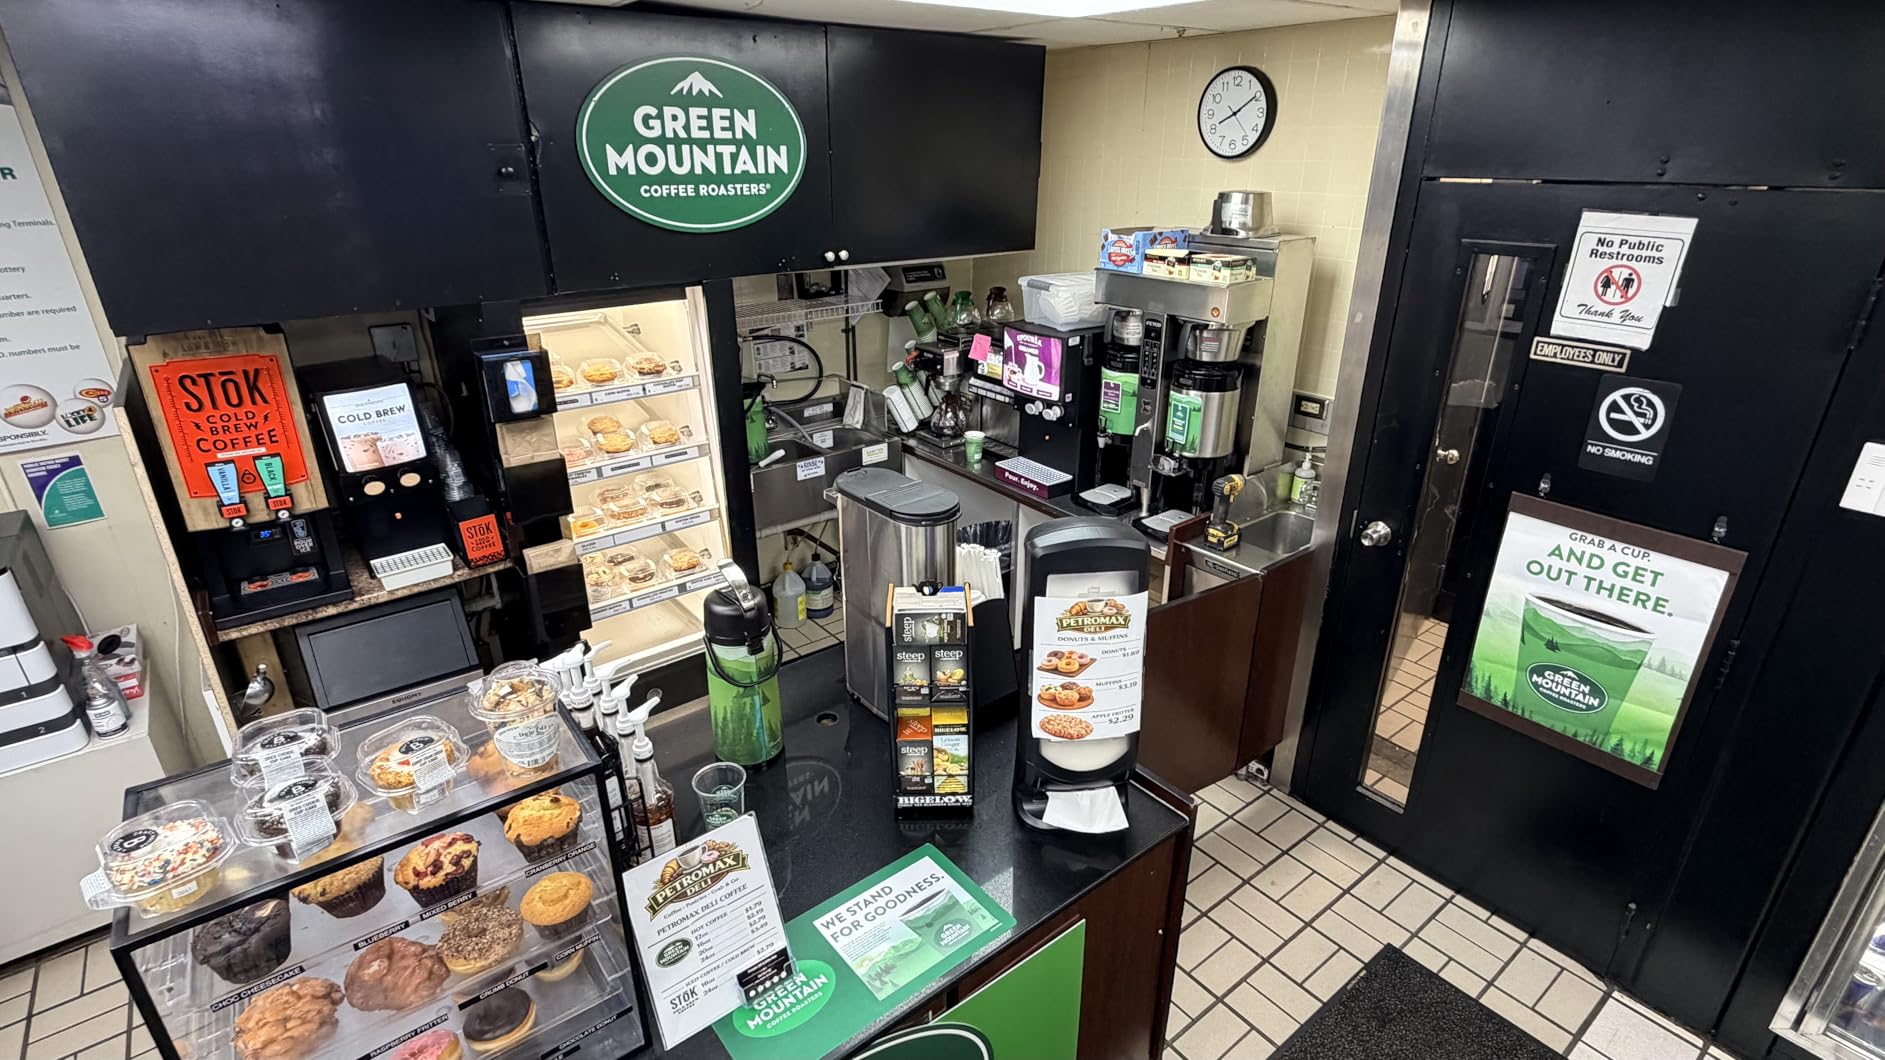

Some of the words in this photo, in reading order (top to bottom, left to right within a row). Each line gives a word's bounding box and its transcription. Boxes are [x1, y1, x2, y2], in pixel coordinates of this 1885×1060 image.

[1222, 81, 1229, 92] 11
[1233, 75, 1243, 87] 12
[1212, 93, 1222, 104] 10
[1254, 91, 1262, 102] 2
[633, 105, 757, 139] GREEN
[1207, 109, 1215, 119] 9
[1257, 107, 1265, 118] 3
[1209, 124, 1217, 134] 8
[1251, 123, 1259, 134] 4
[1219, 136, 1226, 146] 7
[1229, 140, 1237, 150] 6
[1241, 135, 1249, 146] 5
[606, 144, 788, 175] MOUNTAIN
[640, 184, 695, 197] COFFEE
[12, 219, 56, 227] Terminals.
[1596, 237, 1614, 249] No
[1618, 238, 1664, 253] Public
[1589, 248, 1664, 265] Restrooms
[42, 305, 77, 316] required
[1577, 304, 1613, 318] Thank
[1620, 309, 1644, 323] You
[1536, 342, 1593, 363] EMPLOYEES
[1596, 350, 1623, 366] ONLY
[206, 410, 257, 425] COLD
[337, 411, 372, 424] COLD
[375, 404, 406, 418] BREW
[209, 421, 259, 436] BREW
[196, 428, 279, 453] COFFEE
[1587, 444, 1602, 455] NO
[1604, 448, 1653, 465] SMOKING
[264, 462, 277, 482] BLACK
[1004, 471, 1020, 483] Pour.
[1020, 477, 1039, 491] Enjoy.
[471, 541, 496, 552] COFFEE
[1569, 532, 1605, 550] GRAB
[1607, 543, 1618, 553] A
[1621, 545, 1651, 562] CUP.
[1547, 543, 1606, 572] AND
[1612, 560, 1664, 588] GET
[1526, 559, 1577, 587] OUT
[1583, 574, 1674, 617] THERE.
[902, 617, 912, 642] steep
[1063, 616, 1126, 627] PETROMAX
[897, 652, 925, 662] steep
[935, 650, 963, 660] steep
[1532, 674, 1600, 707] MOUNTAIN
[1544, 671, 1590, 693] GREEN
[1108, 714, 1134, 725] $2.29
[901, 746, 928, 755] steep
[525, 855, 567, 877] CRANBERRY
[567, 843, 596, 861] ORANGE
[655, 855, 737, 903] PETROMAX
[686, 878, 712, 897] DELI
[422, 904, 447, 920] MIXED
[448, 893, 473, 908] BERRY
[657, 909, 700, 936] PETROMAX
[701, 899, 719, 913] DELI
[719, 883, 748, 902] COFFEE
[821, 913, 846, 930] WE
[846, 885, 894, 916] STAND
[830, 920, 864, 943] FOR
[864, 873, 945, 922] GOODNESS.
[691, 924, 704, 935] HOT
[705, 911, 728, 927] COFFEE
[941, 924, 962, 939] GREEN
[358, 923, 406, 949] BLUEBERRY
[940, 925, 971, 946] MOUNTAIN
[556, 946, 577, 960] CORN
[577, 935, 599, 952] MUFFIN
[212, 997, 240, 1012] CHOC
[241, 967, 301, 998] CHEESECAKE
[480, 984, 505, 999] CRUMB
[505, 971, 530, 988] DONUT
[753, 973, 808, 1010] GREEN
[746, 974, 829, 1030] MOUNTAIN
[767, 1011, 791, 1028] COFFEE
[791, 992, 823, 1012] ROASTERS
[370, 1030, 416, 1057] RASPBERRY
[417, 1014, 449, 1035] FRITTER
[559, 1026, 596, 1050] CHOCOLATE
[596, 1015, 618, 1032] DONUT
